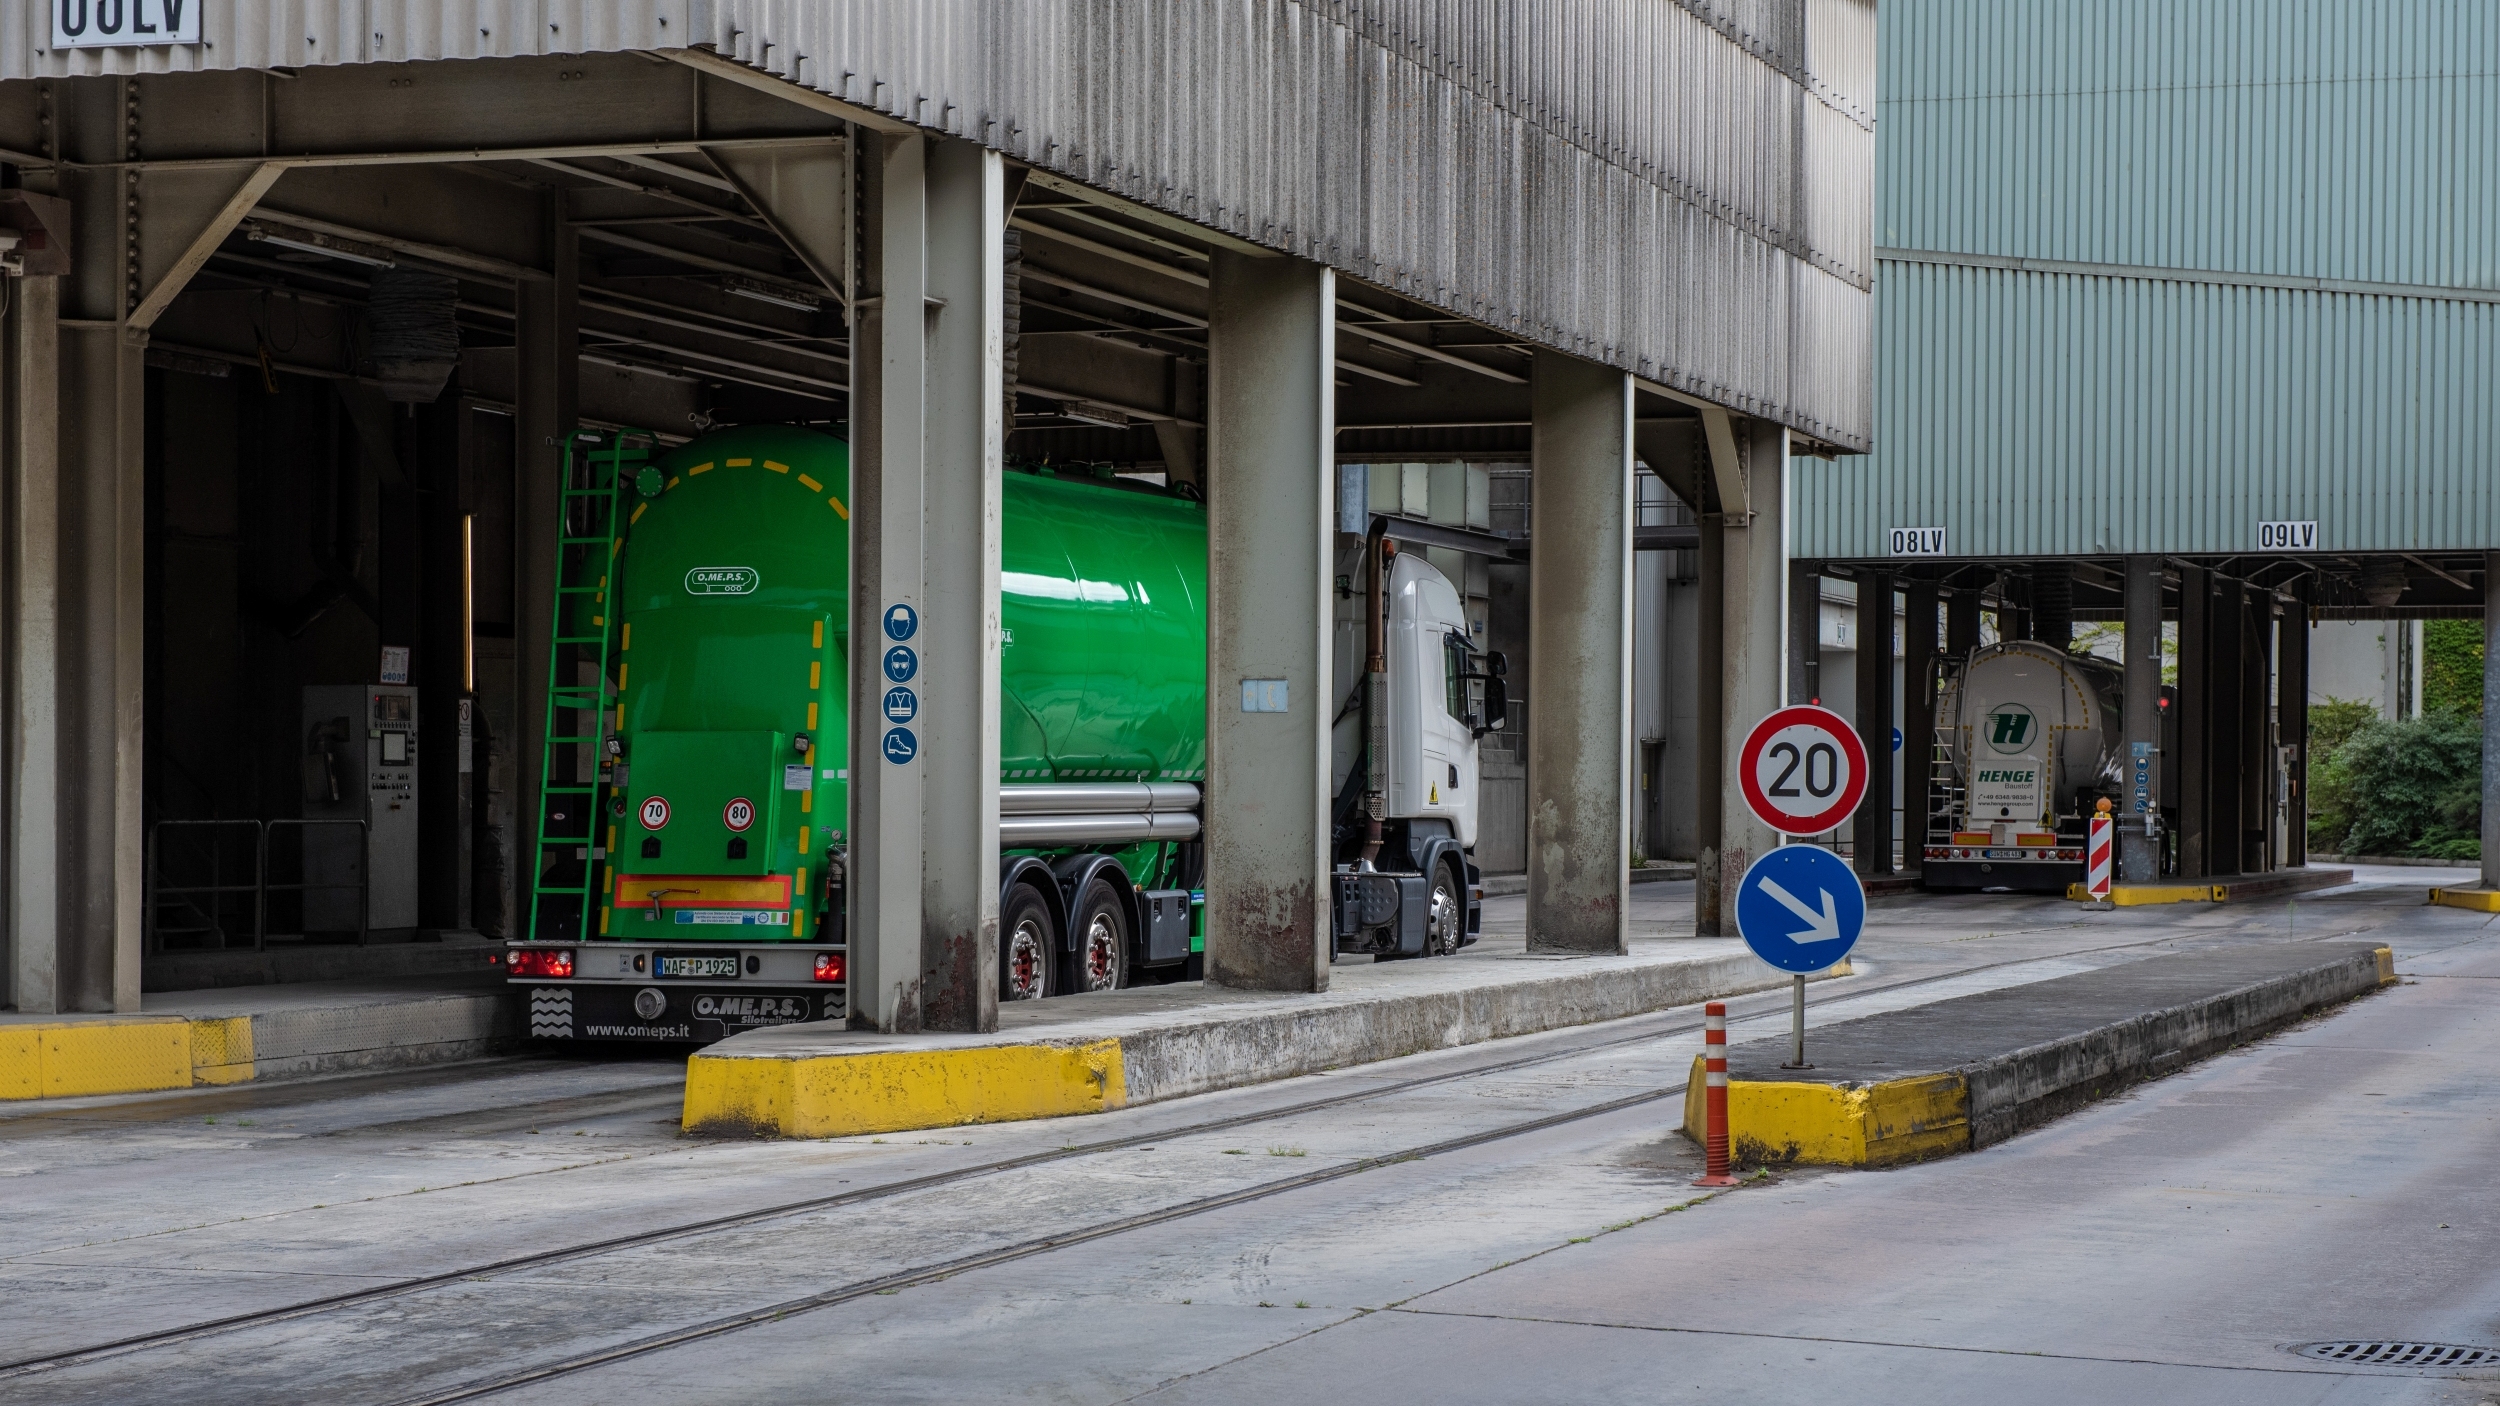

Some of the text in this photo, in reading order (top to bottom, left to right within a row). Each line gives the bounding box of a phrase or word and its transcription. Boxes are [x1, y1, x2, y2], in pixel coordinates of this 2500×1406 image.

[1892, 530, 1943, 554] 08LV
[2261, 524, 2314, 548] 09LV
[1768, 742, 1838, 798] 20
[1978, 770, 2036, 783] HENGE
[648, 804, 663, 818] 70
[732, 806, 748, 820] 80
[663, 959, 686, 974] WAF
[695, 959, 703, 974] P
[706, 959, 735, 974] 1925
[697, 997, 800, 1016] O.ME.P.S.
[741, 1015, 797, 1025] Silotrailers
[586, 1023, 690, 1041] www.omeps.it
